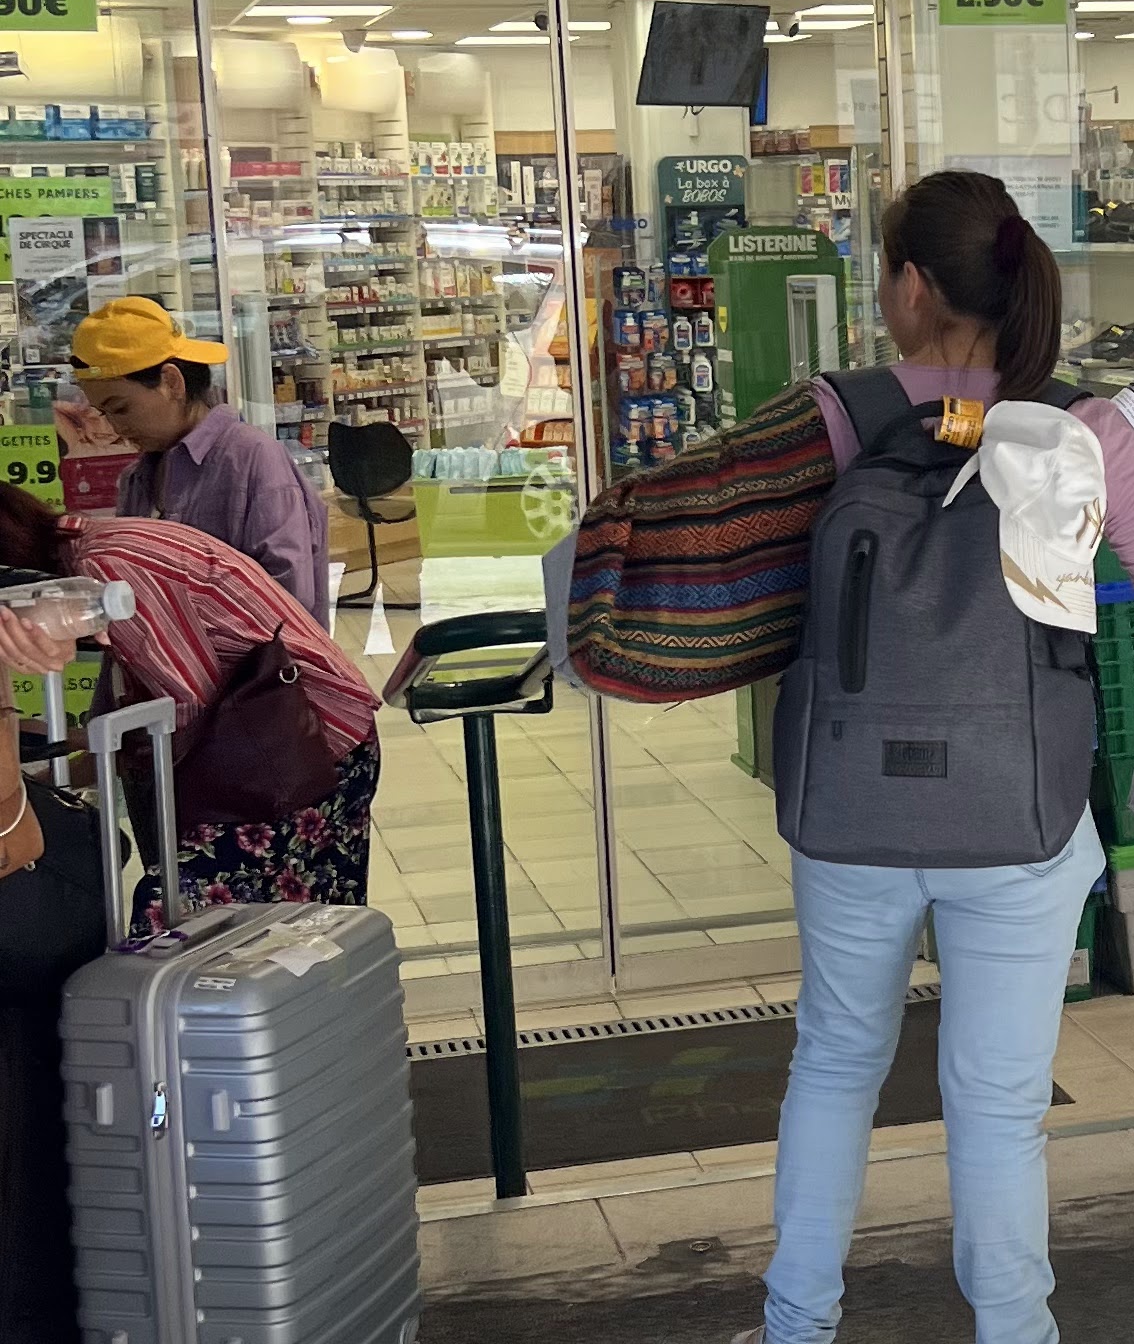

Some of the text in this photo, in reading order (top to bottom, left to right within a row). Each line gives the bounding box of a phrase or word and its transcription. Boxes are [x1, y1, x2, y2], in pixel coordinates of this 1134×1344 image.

[686, 159, 732, 173] URGO
[677, 177, 693, 189] La
[696, 177, 716, 189] box
[38, 187, 100, 199] PAMPERS
[682, 189, 727, 203] BOBOS
[19, 230, 73, 241] SPECTACLE
[19, 240, 71, 250] DE CIRQUE
[729, 234, 818, 253] LISTERINE
